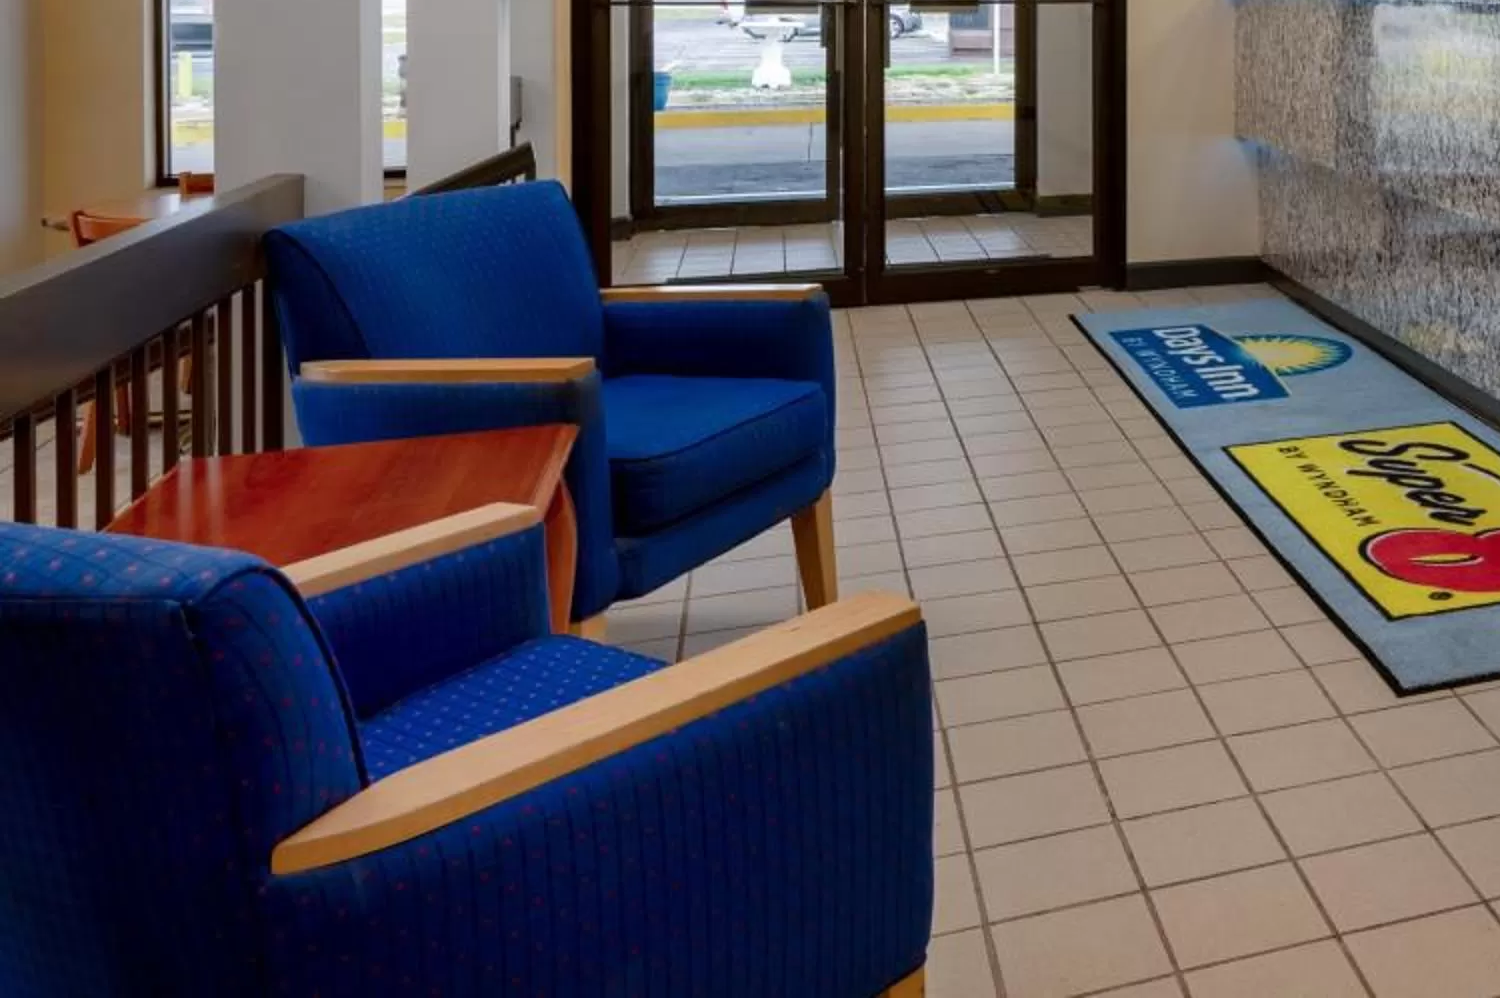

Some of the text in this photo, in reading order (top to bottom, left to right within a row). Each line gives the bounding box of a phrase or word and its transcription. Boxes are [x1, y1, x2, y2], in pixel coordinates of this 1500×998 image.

[1152, 326, 1260, 399] Days Inn
[1277, 445, 1382, 527] BY WYNDHAM
[1337, 439, 1488, 527] Super
